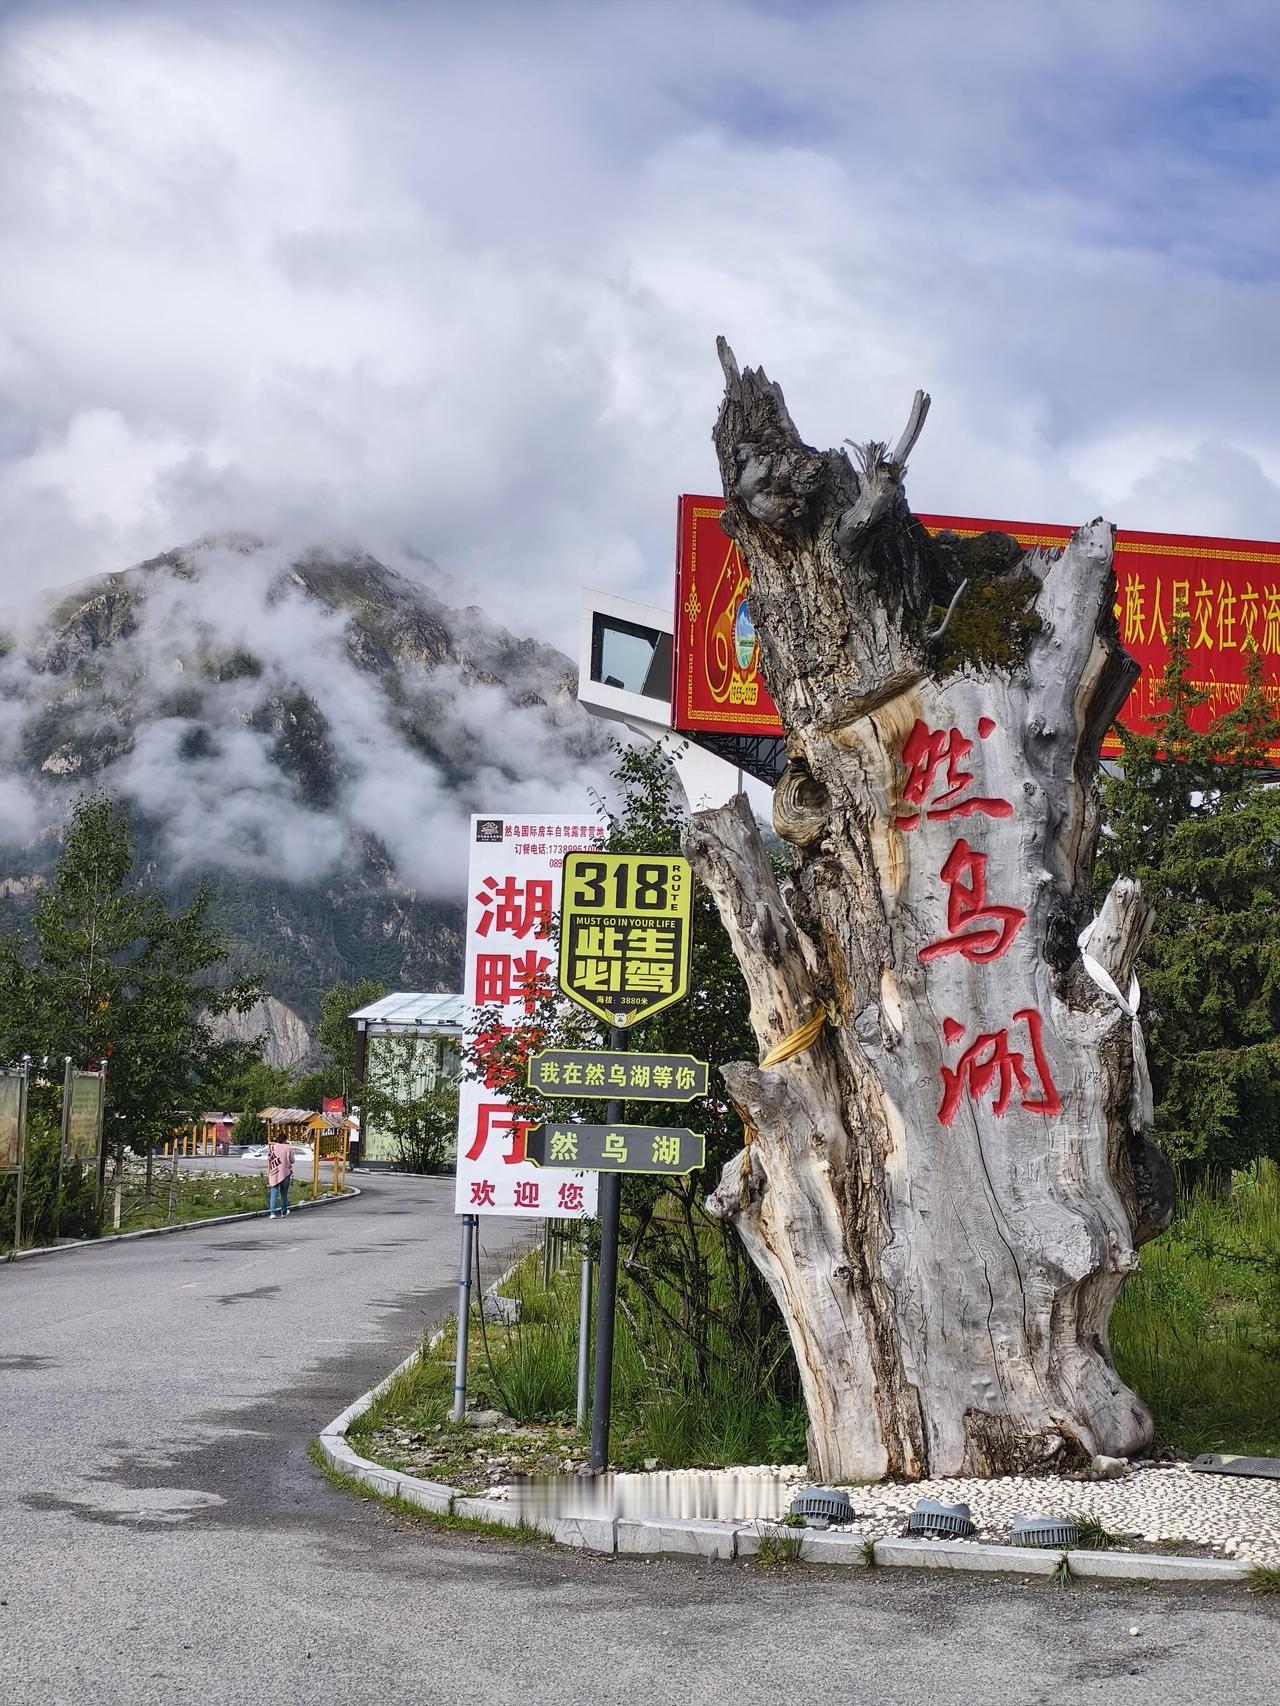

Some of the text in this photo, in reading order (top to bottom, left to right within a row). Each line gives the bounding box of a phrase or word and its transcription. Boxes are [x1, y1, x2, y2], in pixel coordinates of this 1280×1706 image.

[1113, 573, 1280, 655] 族人民交往交流
[549, 858, 563, 868] 089
[574, 862, 668, 910] 318
[670, 865, 682, 911] ROUTE
[576, 917, 676, 928] MUST GO IN YOUR LIFE
[575, 926, 675, 959] 此生
[573, 959, 674, 993] 必驾
[540, 1062, 696, 1090] 我在然乌湖等你
[550, 1131, 681, 1166] 然乌湖
[470, 1180, 585, 1210] 欢迎您
